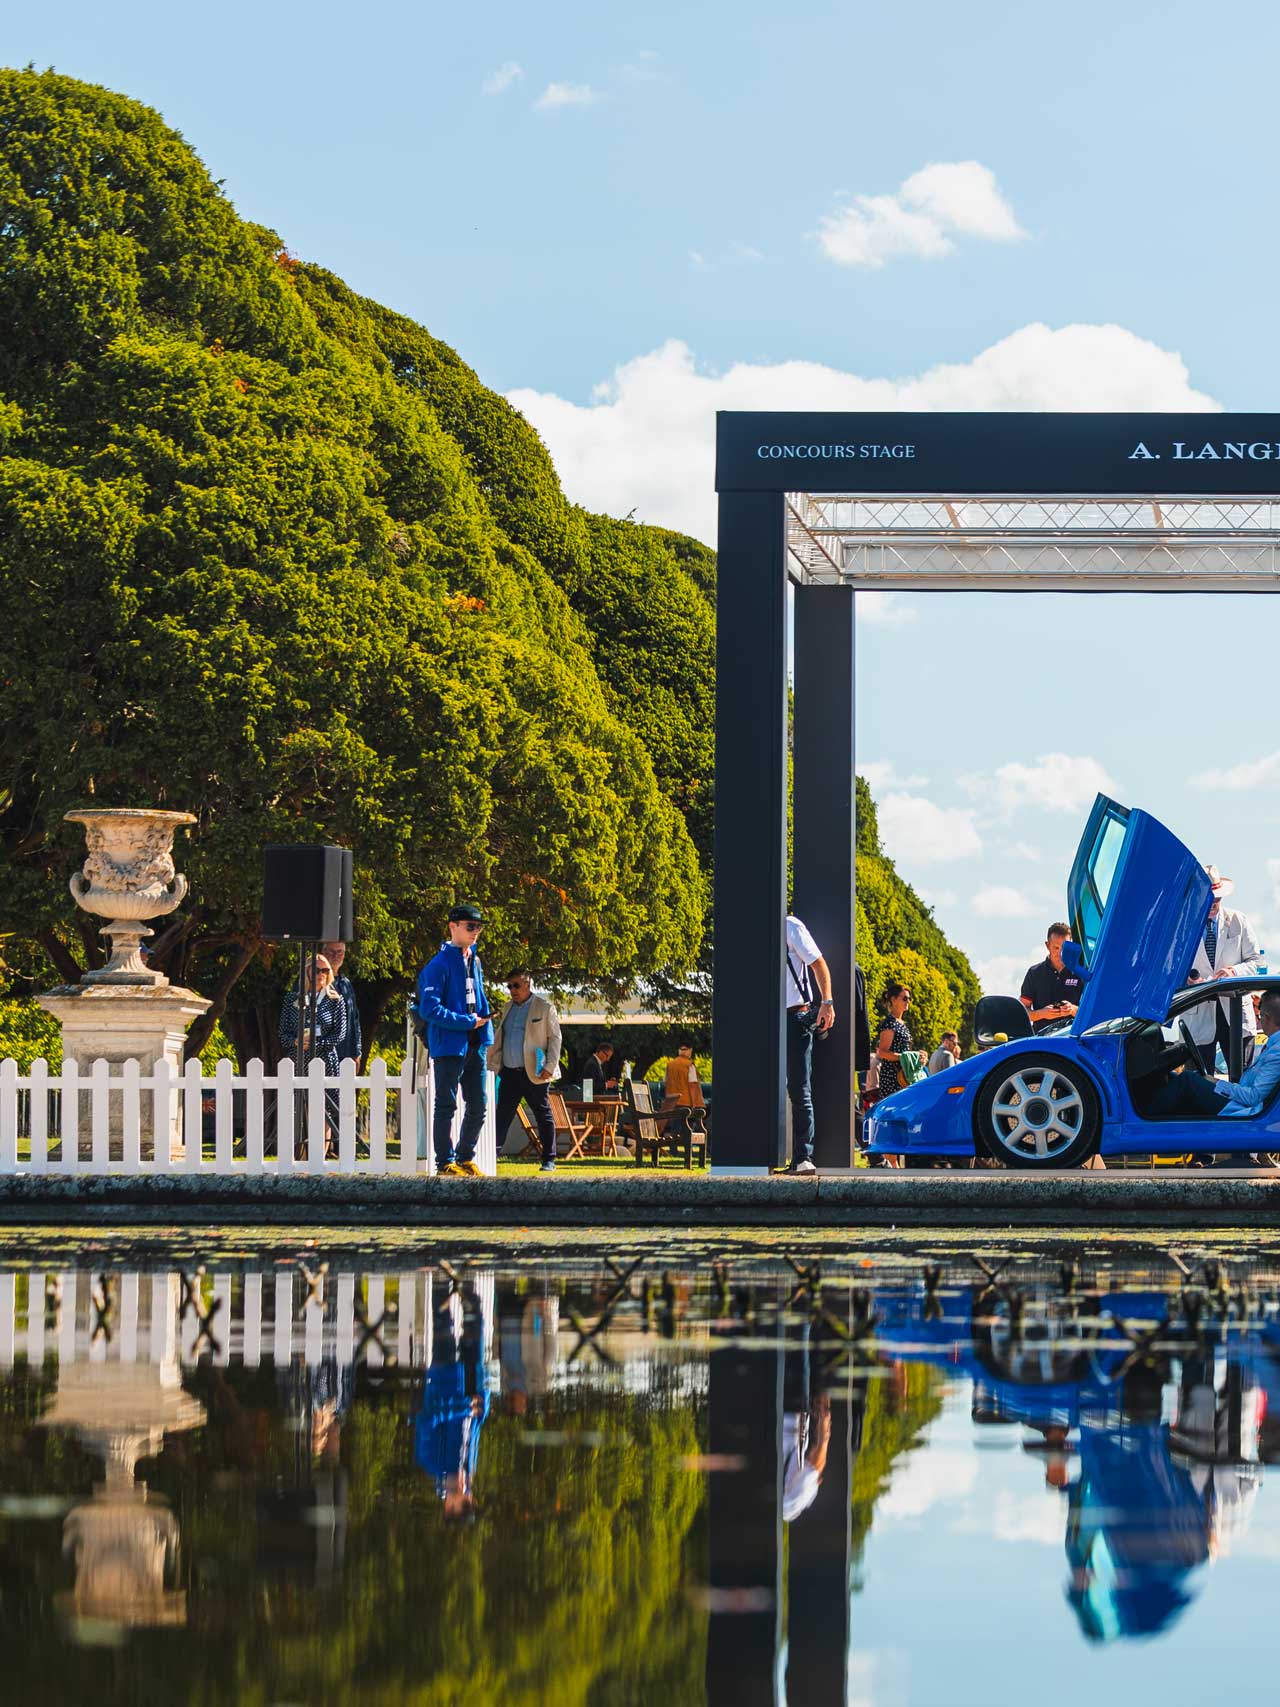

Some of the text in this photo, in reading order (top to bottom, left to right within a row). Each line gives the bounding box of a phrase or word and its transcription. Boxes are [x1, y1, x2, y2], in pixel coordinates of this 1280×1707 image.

[757, 445, 916, 459] CONCOURS STAGE
[1128, 441, 1161, 460] A.
